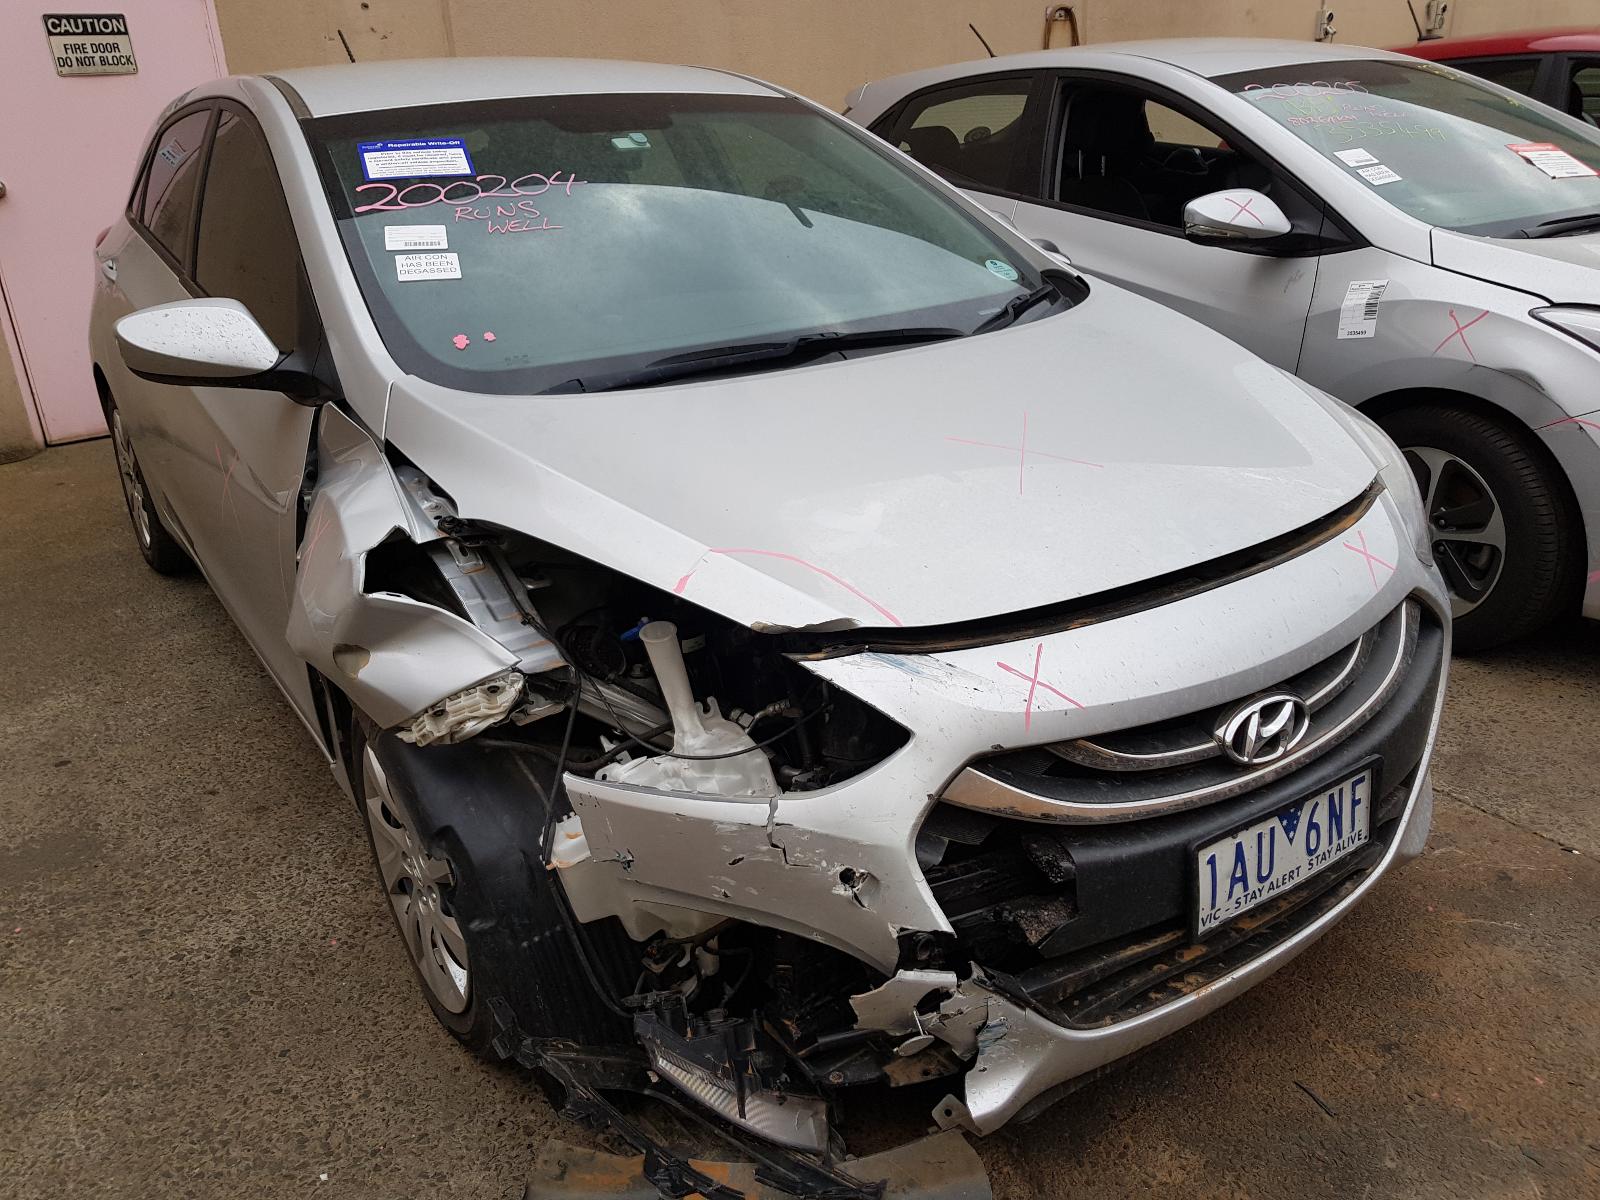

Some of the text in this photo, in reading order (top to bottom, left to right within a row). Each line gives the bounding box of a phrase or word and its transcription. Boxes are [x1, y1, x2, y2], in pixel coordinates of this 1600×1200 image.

[47, 18, 126, 33] CAUTION
[63, 42, 121, 55] FIRE DOOR
[57, 54, 134, 68] DO NOT BLOCK
[354, 170, 588, 213] 200204
[455, 200, 540, 222] RUNS
[488, 217, 563, 234] WELL
[399, 267, 457, 275] DEGASSED
[1206, 775, 1366, 911] 1AU 6NF
[1200, 908, 1221, 927] VIC
[1234, 885, 1266, 910] STAY
[1267, 865, 1302, 894] ALERT
[1307, 847, 1334, 871] STAY
